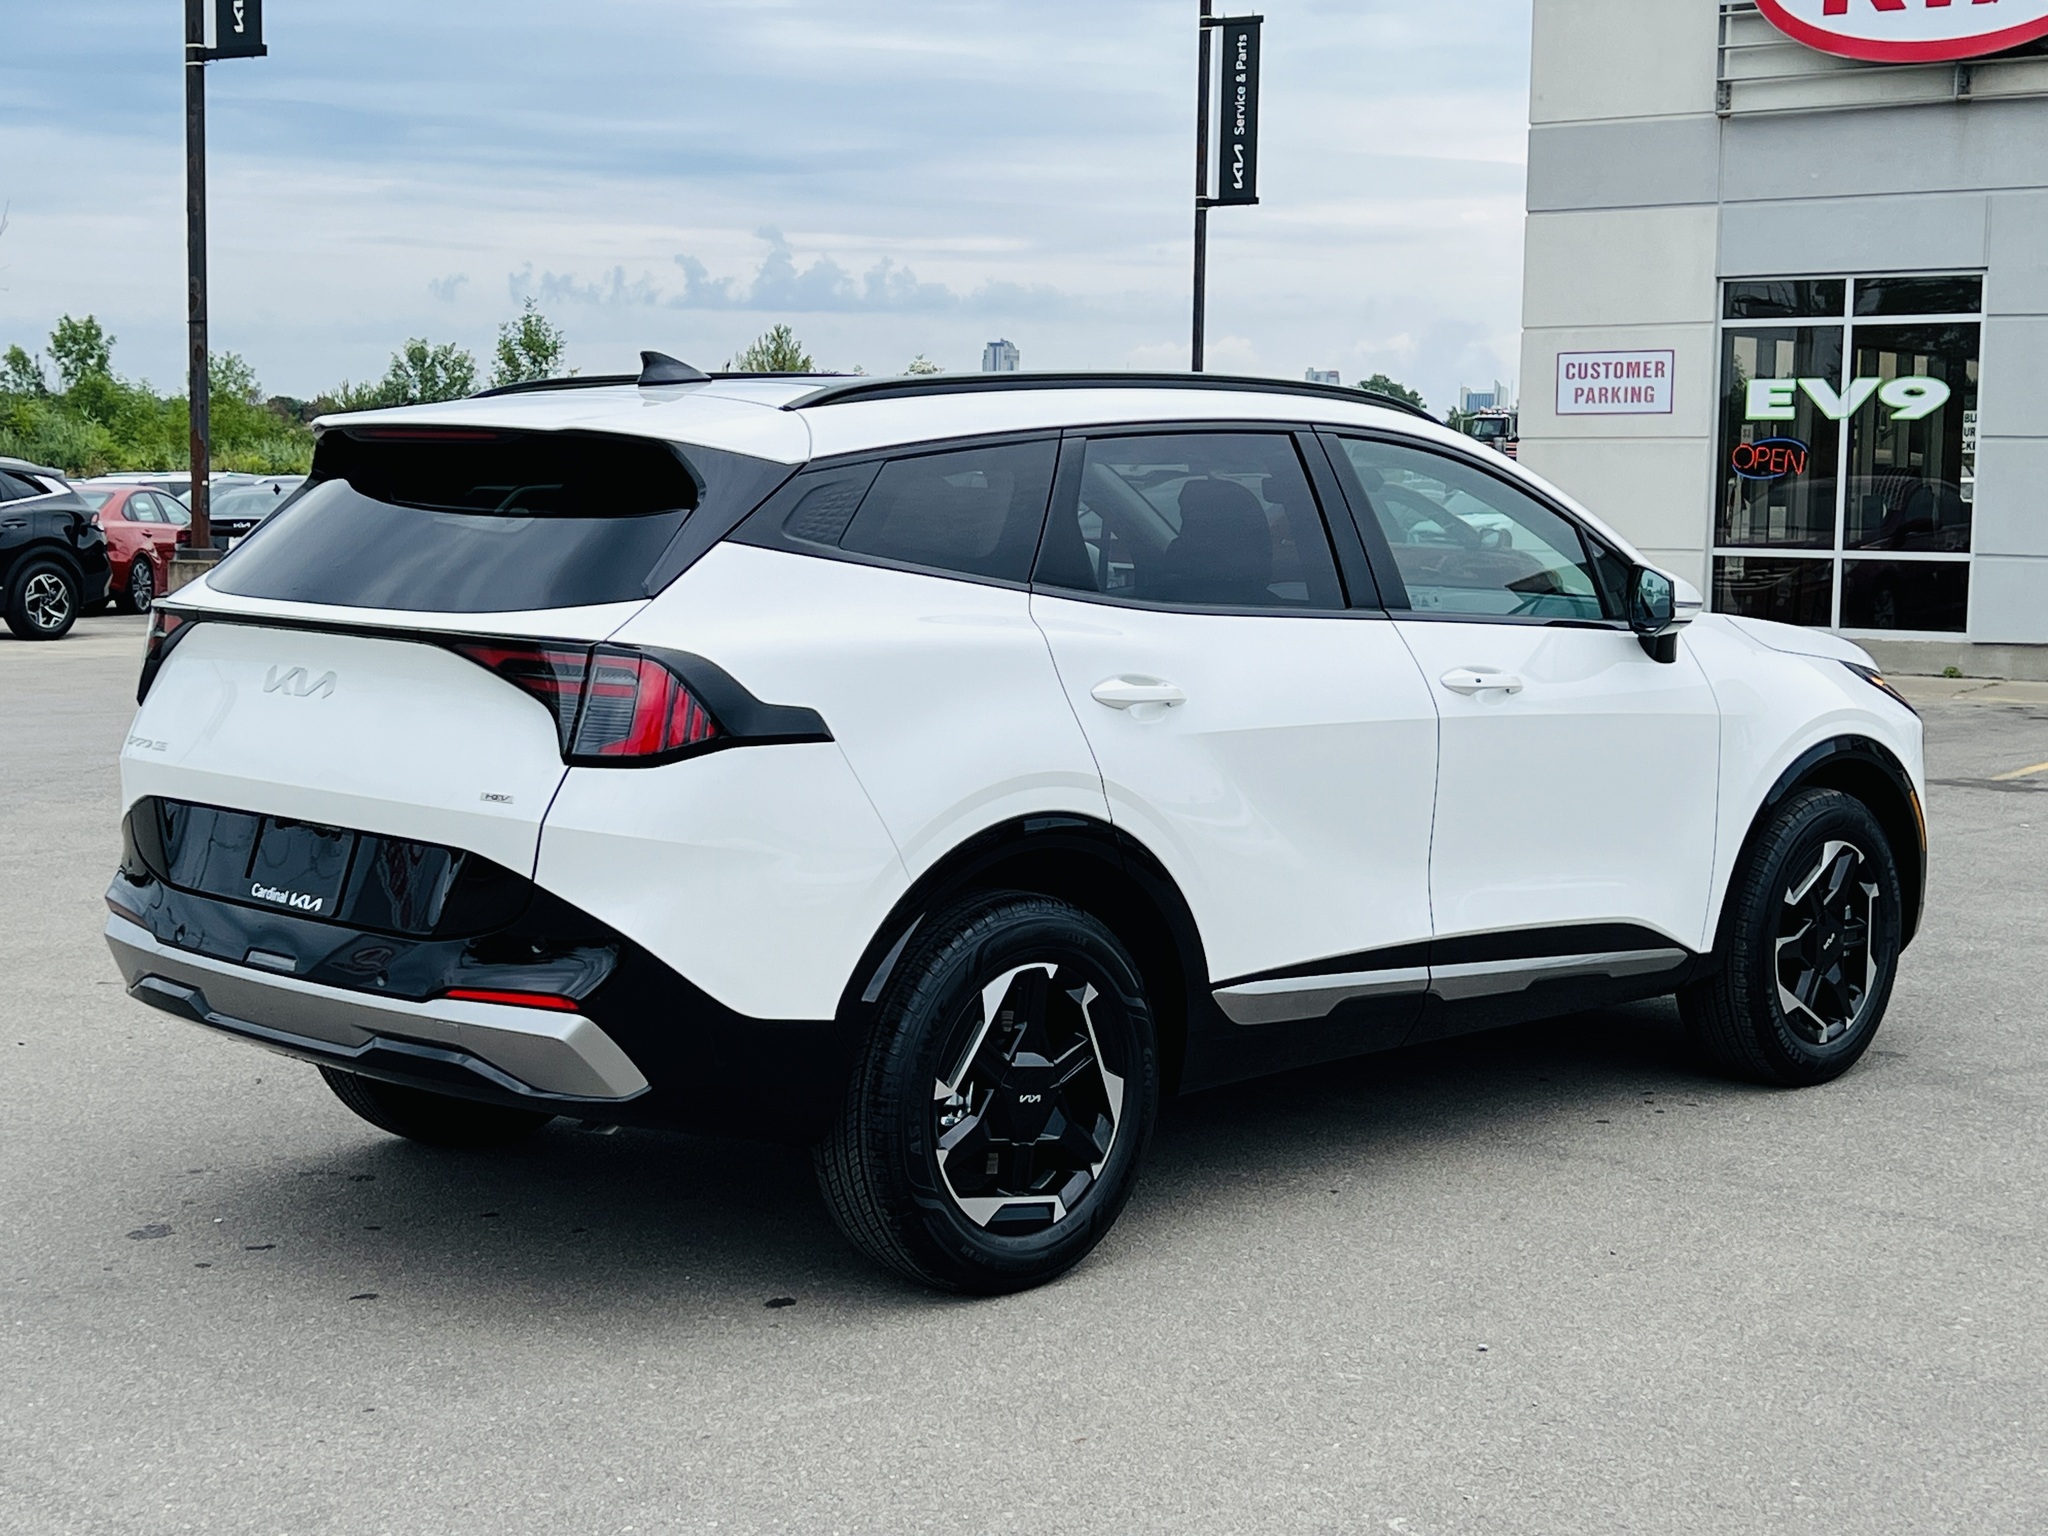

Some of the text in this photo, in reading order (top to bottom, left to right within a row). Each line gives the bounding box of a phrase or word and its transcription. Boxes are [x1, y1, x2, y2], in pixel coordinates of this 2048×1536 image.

[1236, 33, 1248, 70] Parts
[1235, 73, 1247, 83] &
[1234, 86, 1246, 135] Service
[1565, 361, 1666, 380] CUSTOMER
[1574, 386, 1655, 404] PARKING
[1745, 376, 1951, 421] EV9
[1732, 443, 1805, 475] OPEN
[263, 665, 338, 699] KIA
[251, 883, 289, 904] Cardinal
